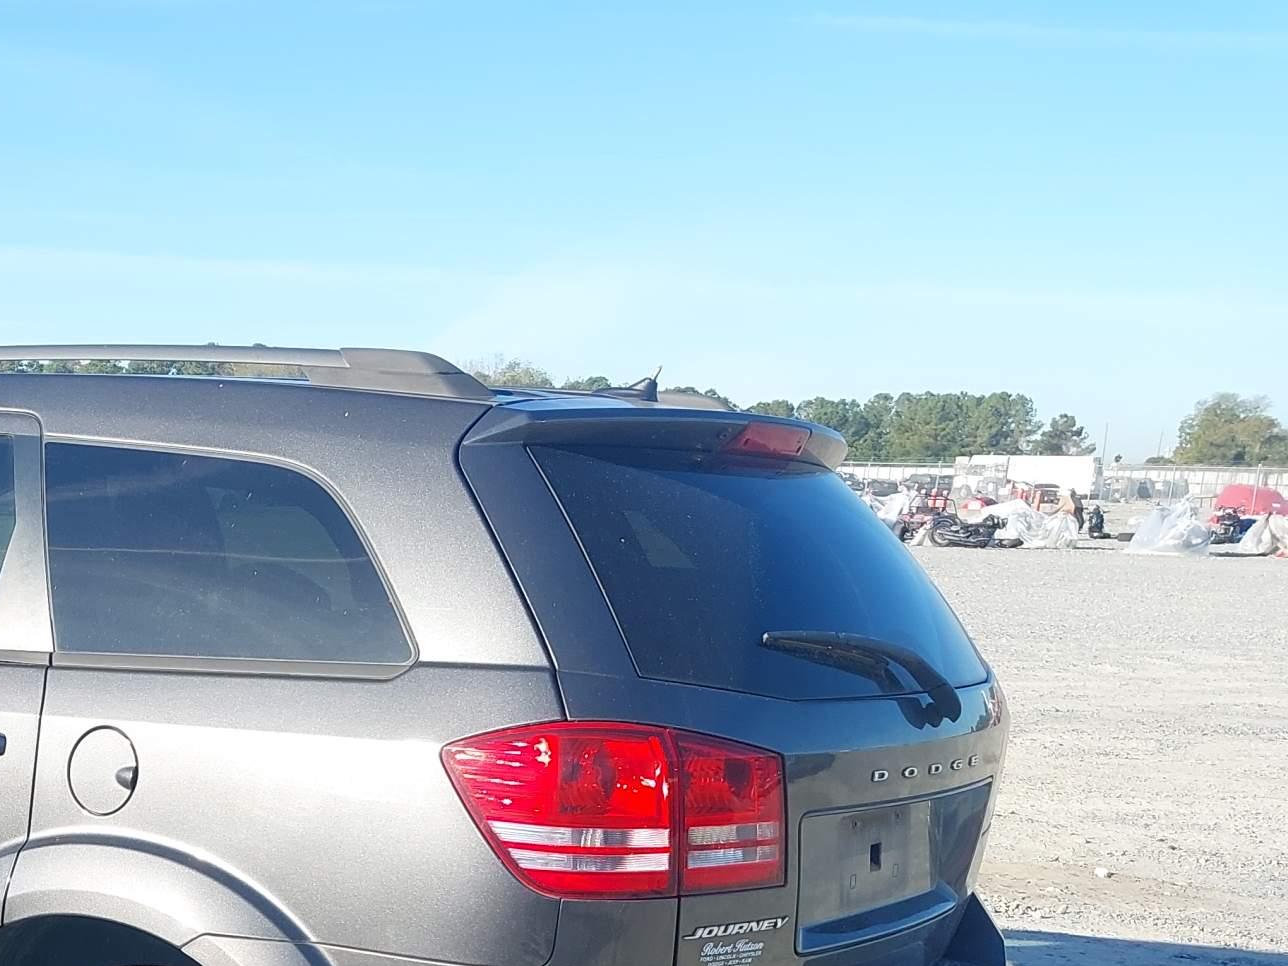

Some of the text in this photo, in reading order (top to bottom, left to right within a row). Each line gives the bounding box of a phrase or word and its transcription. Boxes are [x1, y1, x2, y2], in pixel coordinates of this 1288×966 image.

[871, 755, 979, 782] DODGE
[683, 916, 789, 940] JOURNEY
[700, 941, 733, 956] Robert
